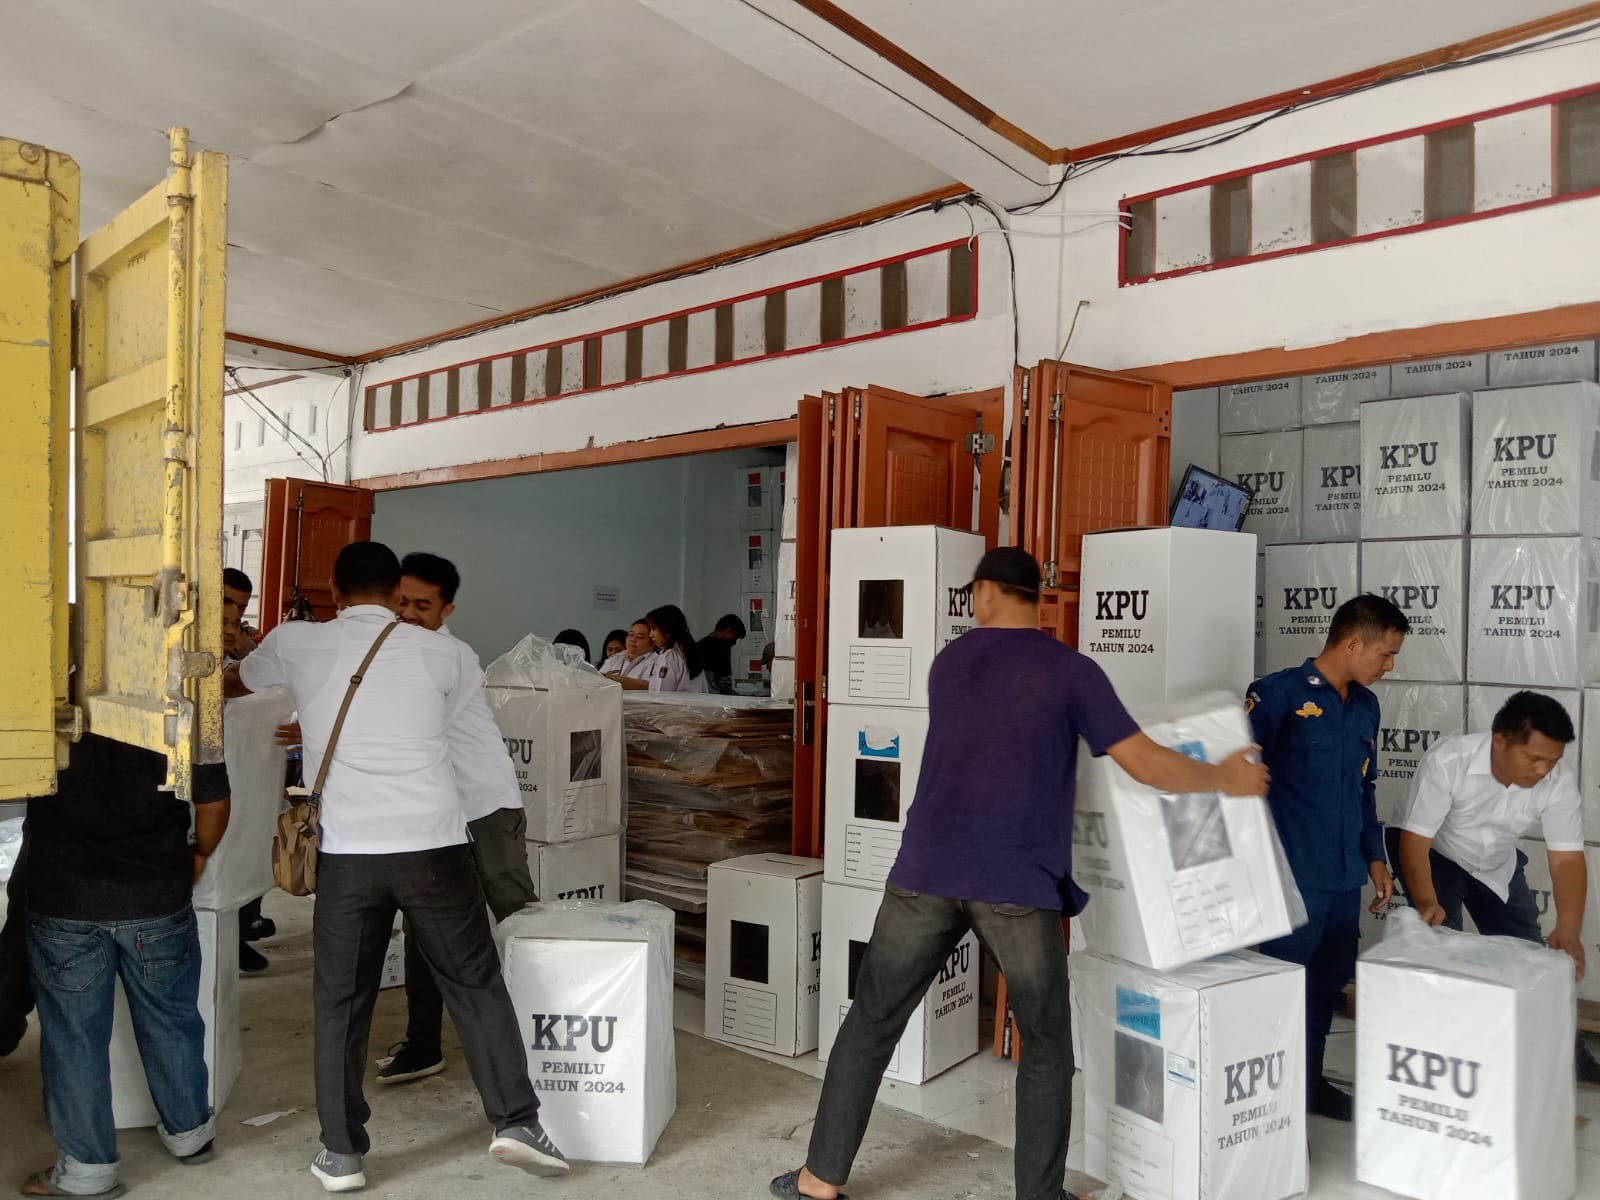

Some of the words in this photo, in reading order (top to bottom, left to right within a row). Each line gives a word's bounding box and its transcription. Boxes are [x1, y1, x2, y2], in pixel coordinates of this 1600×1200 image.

[1504, 350, 1545, 361] TAHUN
[1549, 346, 1579, 357] 2024
[1405, 363, 1442, 374] TAHUN
[1445, 360, 1472, 370] 2024
[1314, 374, 1349, 384] TAHUN
[1352, 371, 1377, 380] 2024
[1230, 385, 1263, 395] TAHUN
[1266, 382, 1289, 392] 2024
[1380, 441, 1439, 469] KPU
[1493, 434, 1557, 462] KPU
[1388, 472, 1432, 483] PEMILU
[1501, 466, 1548, 476] PEMILU
[1375, 485, 1414, 495] TAHUN
[1417, 482, 1446, 493] 2024
[1487, 479, 1528, 489] TAHUN
[1532, 477, 1563, 487] 2024
[1327, 492, 1361, 501] PEMIL
[1266, 506, 1290, 515] 2024
[1315, 503, 1350, 512] TAHUN
[948, 587, 975, 618] KPU
[1284, 587, 1338, 610] KPU
[1490, 585, 1555, 610] KPU
[1096, 590, 1149, 620] KPU
[1291, 615, 1331, 624] PEMILU
[1498, 616, 1545, 625] PEMILU
[1102, 629, 1141, 638] PEMILU
[1279, 627, 1315, 635] TAHUN
[1417, 627, 1447, 636] 2024
[1483, 628, 1526, 637] TAHUN
[1530, 629, 1561, 638] 2024
[1090, 643, 1125, 653] TAHUN
[1128, 643, 1154, 653] 2024
[519, 783, 538, 792] 2024
[942, 981, 966, 1001] PEMILU
[935, 1000, 956, 1019] TAHUN
[957, 992, 973, 1008] 2024
[531, 1014, 617, 1053] KPU
[541, 1061, 605, 1075] PEMILU
[1387, 1043, 1481, 1099] KPU
[1224, 1049, 1285, 1105] KPU
[533, 1079, 579, 1092] AHUN
[584, 1081, 625, 1093] 2024
[1232, 1102, 1277, 1126] PEMILU
[1398, 1094, 1469, 1122] PEMILU
[1218, 1125, 1259, 1150] TAHUN
[1263, 1115, 1292, 1134] 2024
[1377, 1107, 1440, 1134] TAHUN
[1445, 1125, 1493, 1147] 2024
